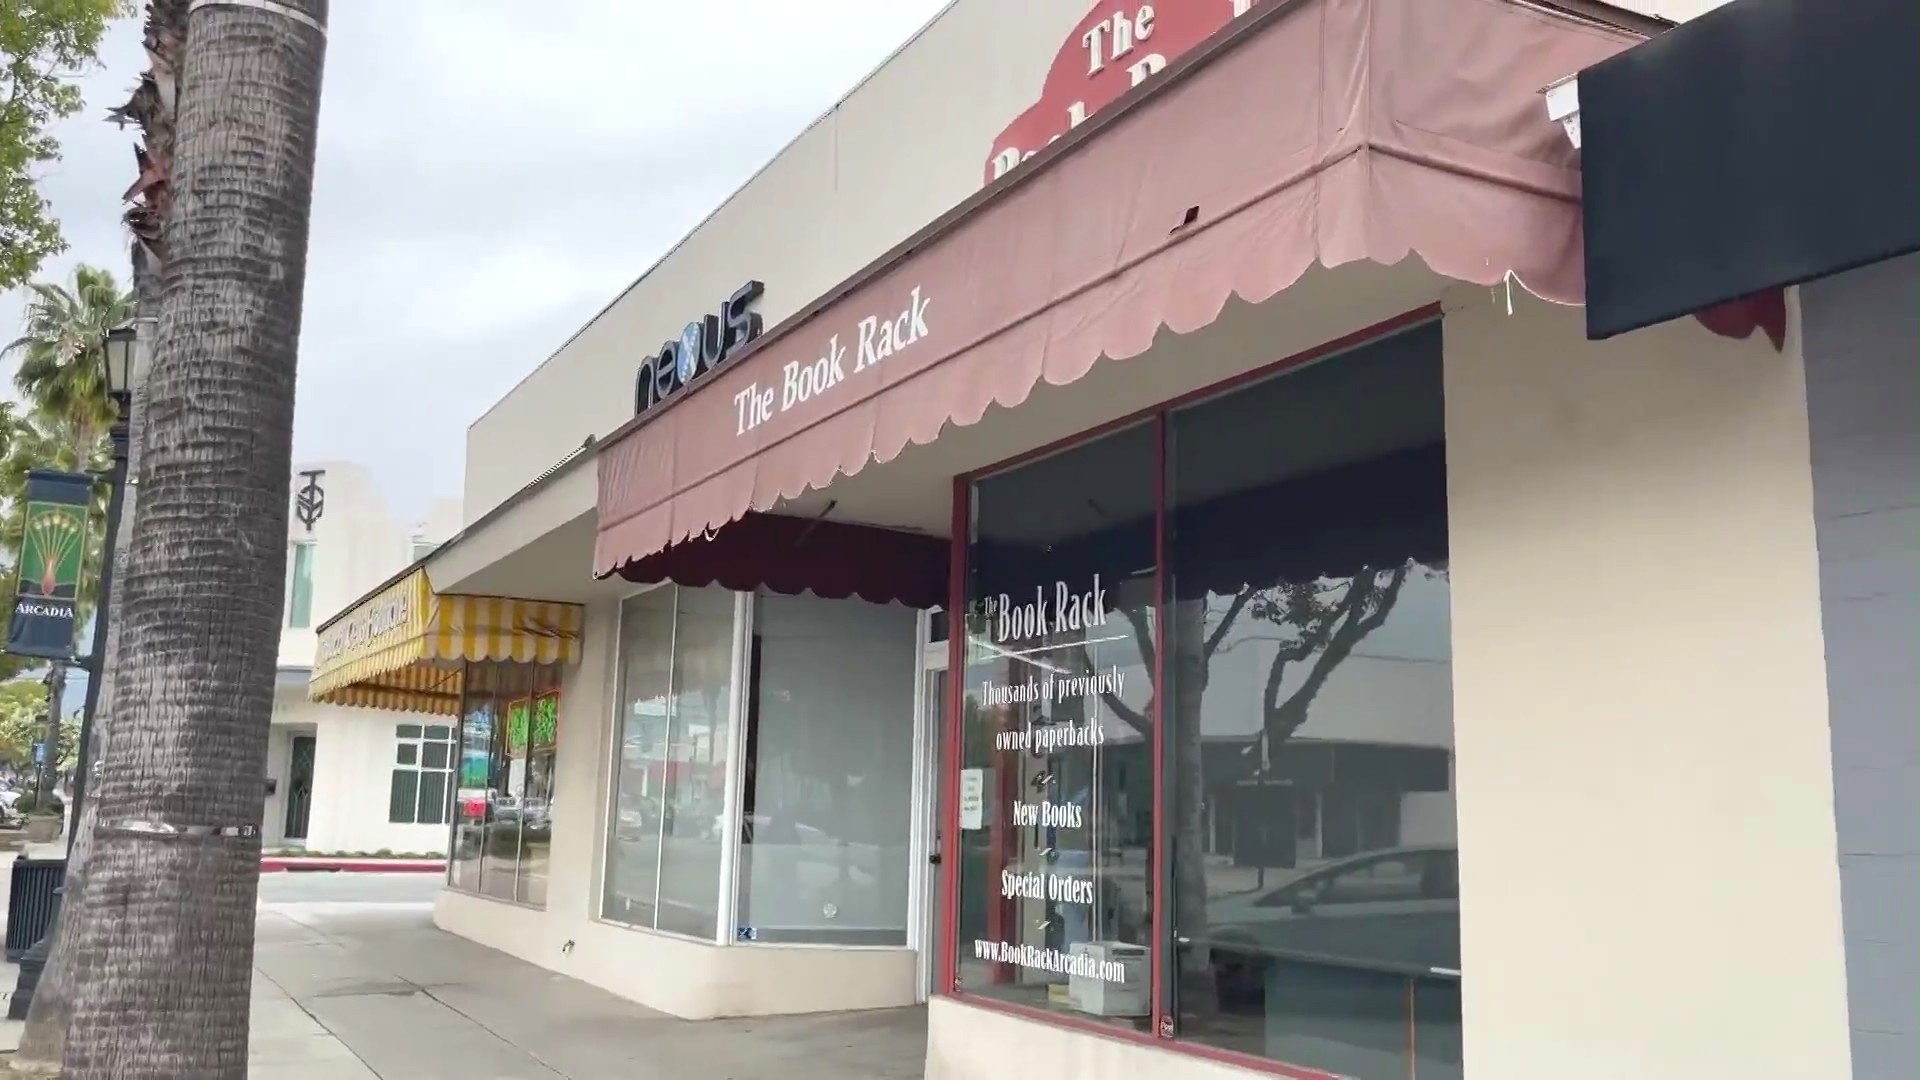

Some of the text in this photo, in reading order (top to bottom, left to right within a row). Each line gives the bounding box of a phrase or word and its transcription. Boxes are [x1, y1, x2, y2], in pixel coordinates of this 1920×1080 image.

[1083, 4, 1155, 78] The
[734, 285, 931, 437] The Book Rack
[15, 602, 74, 618] ARCADIA
[984, 573, 1107, 642] The Book Rack
[983, 665, 1125, 706] Thousands of previously
[996, 717, 1104, 754] owned paperbacks
[1013, 800, 1082, 828] New Books
[1001, 869, 1093, 904] Special Orders
[974, 939, 1125, 983] www.BookRackArcadia.com
